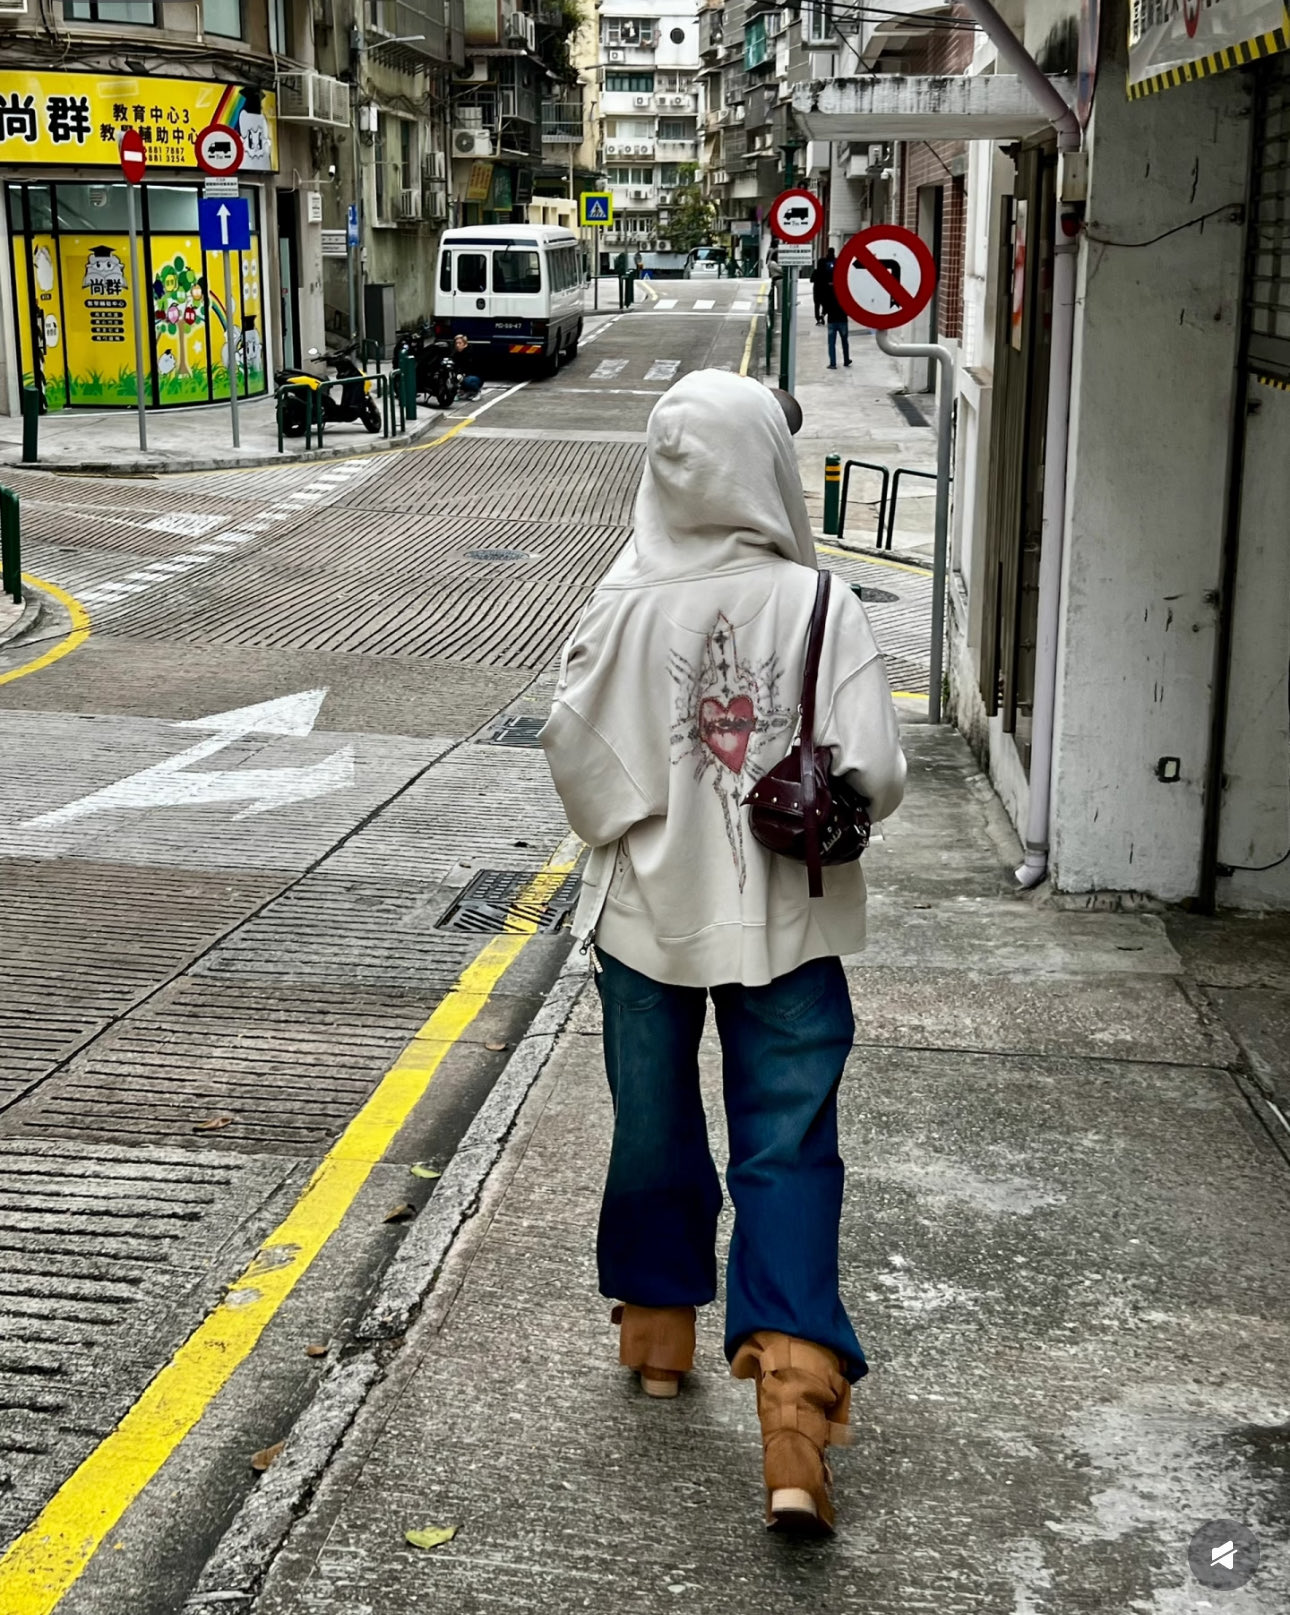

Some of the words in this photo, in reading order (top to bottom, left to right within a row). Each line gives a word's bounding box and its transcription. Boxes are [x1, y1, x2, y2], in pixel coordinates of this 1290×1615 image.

[0, 92, 91, 143] 尚群
[113, 103, 189, 124] 教育中心3
[90, 278, 122, 295] 尚群
